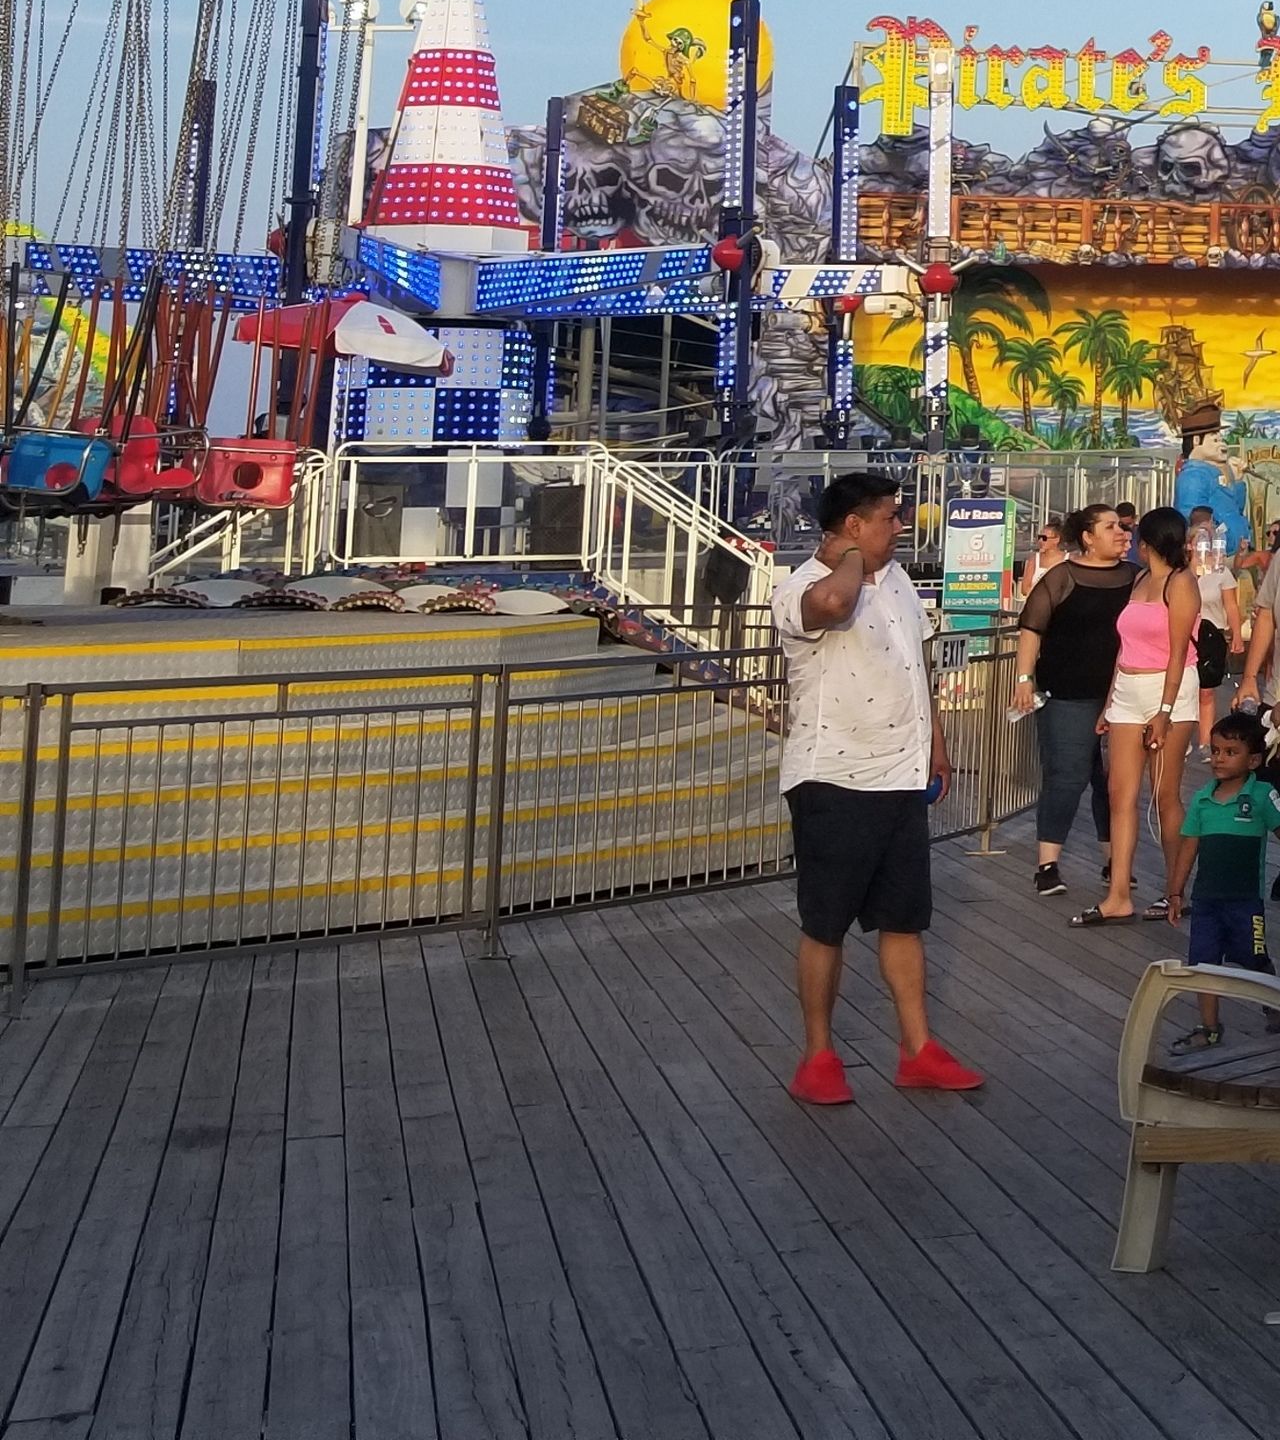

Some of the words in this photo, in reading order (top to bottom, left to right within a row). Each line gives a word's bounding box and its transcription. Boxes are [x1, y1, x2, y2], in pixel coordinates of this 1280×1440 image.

[859, 16, 1211, 136] Pirate's
[950, 508, 971, 520] Air
[972, 509, 1004, 520] Race
[968, 533, 985, 552] 6
[942, 640, 966, 668] EXIT
